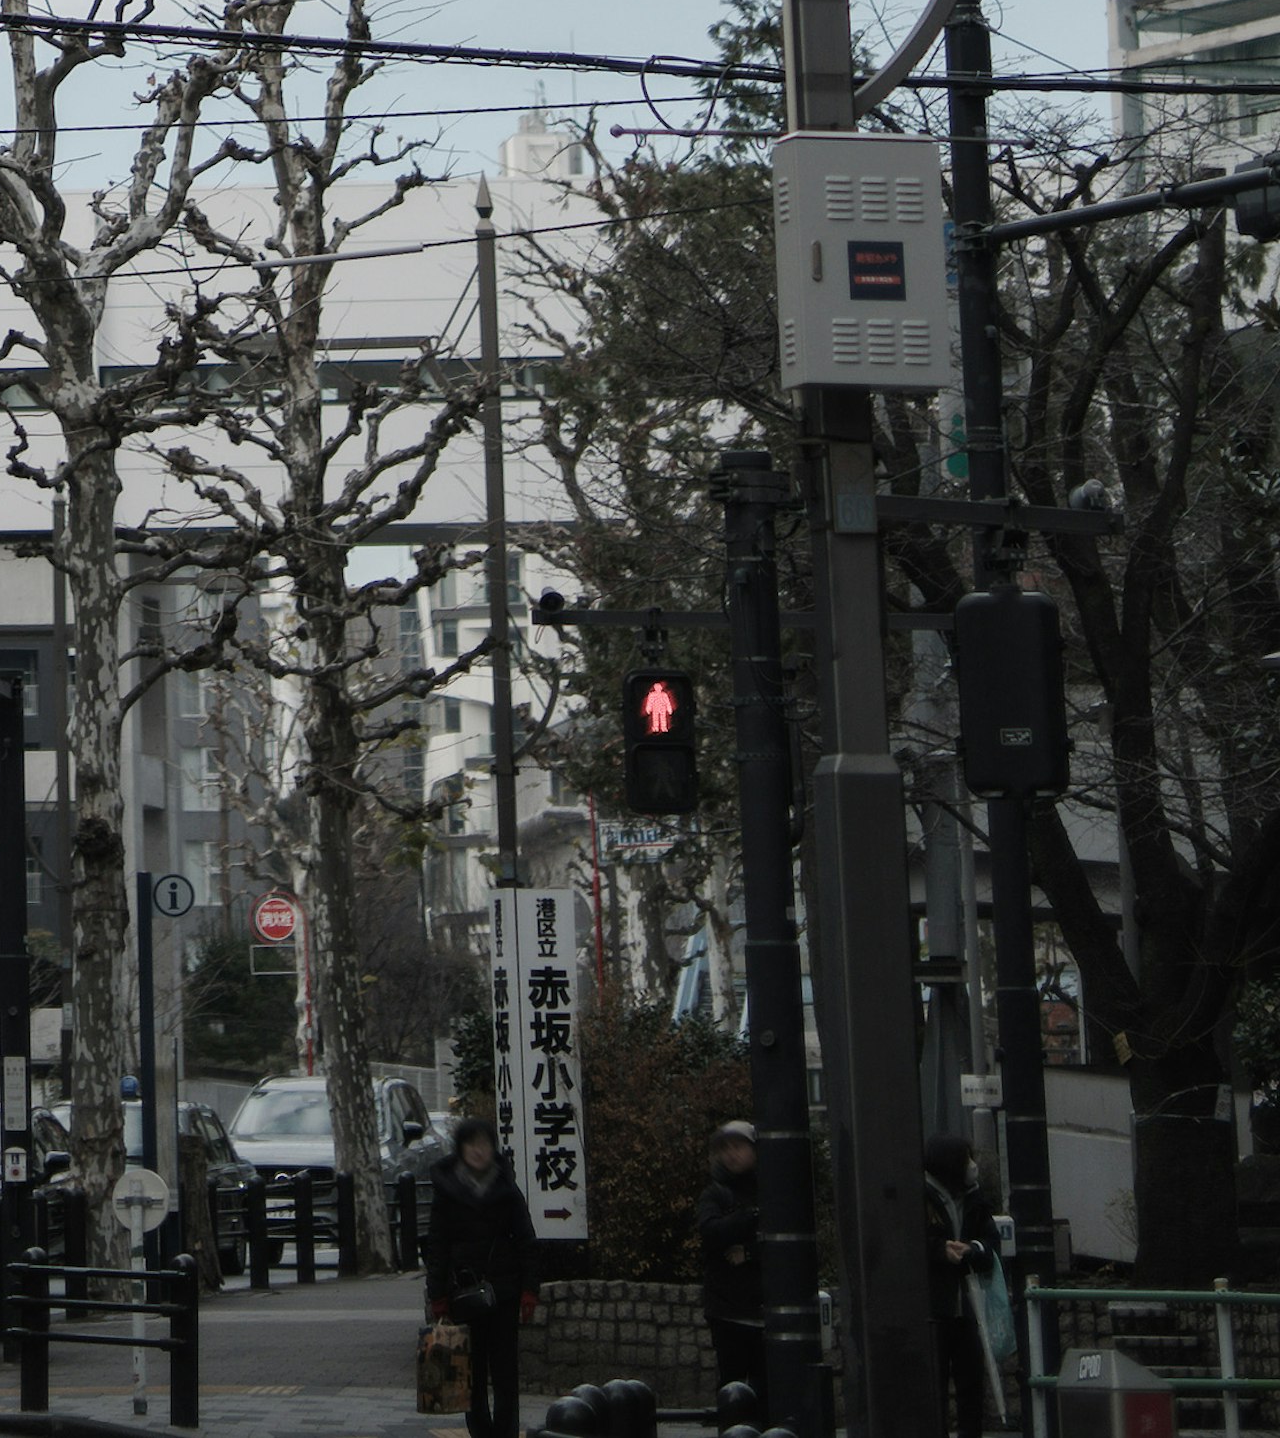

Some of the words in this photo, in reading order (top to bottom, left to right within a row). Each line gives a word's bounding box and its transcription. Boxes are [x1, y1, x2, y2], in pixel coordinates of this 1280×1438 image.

[536, 897, 558, 958] 港区立
[528, 966, 578, 1192] 赤坂小学校
